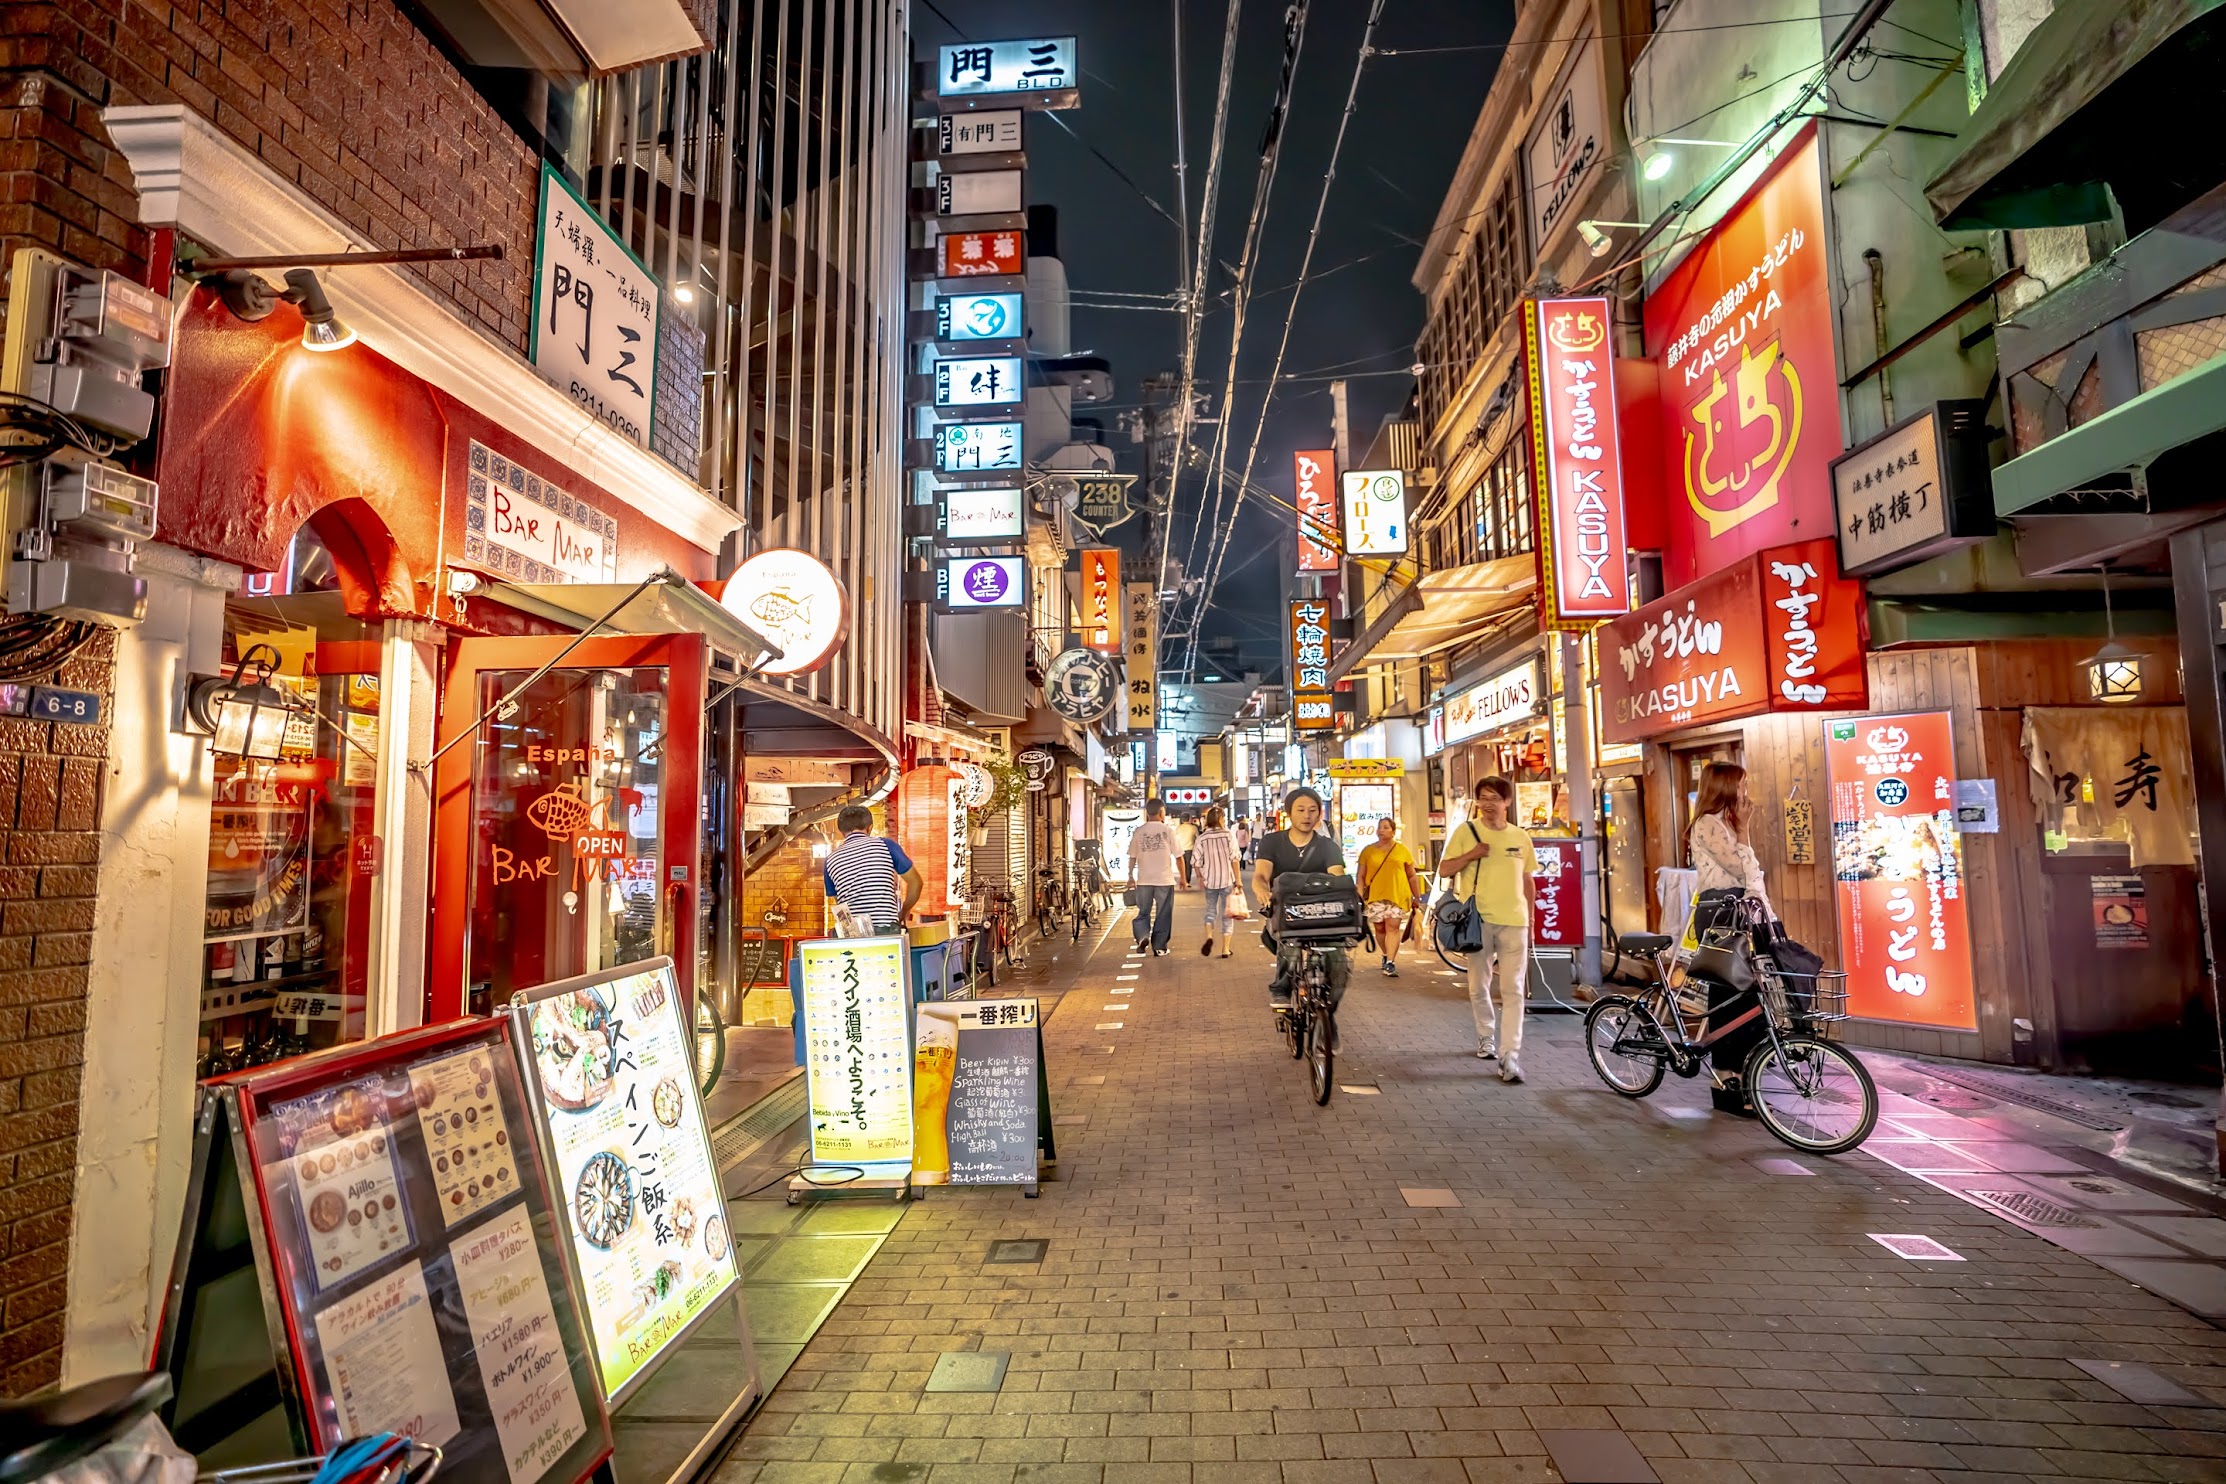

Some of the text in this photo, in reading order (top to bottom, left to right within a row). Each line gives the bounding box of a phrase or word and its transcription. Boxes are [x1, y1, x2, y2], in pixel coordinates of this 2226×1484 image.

[949, 43, 1065, 83] 門三
[1018, 77, 1067, 90] BLD.
[942, 120, 951, 150] 3F
[941, 180, 950, 211] 3F
[1542, 135, 1595, 233] FELLOWS
[1666, 226, 1805, 370] 藤井寺の元祖かすうどん
[550, 261, 645, 399] 門三
[938, 303, 949, 336] 3F
[1683, 288, 1782, 388] KASUYA
[939, 371, 950, 400] 2F
[936, 432, 945, 466] 2F
[956, 445, 1018, 469] 門三
[1852, 448, 1921, 494] 法善寺表参道
[1082, 482, 1122, 505] 238
[936, 502, 947, 531] 1F
[1082, 503, 1119, 518] COUNTER
[1848, 481, 1933, 543] 中筋横丁
[1571, 469, 1613, 600] KASUYA
[936, 568, 949, 600] BF
[972, 565, 998, 589] 煙
[1295, 603, 1328, 688] 七輪焼肉
[1618, 599, 1723, 683] かすうどん
[1770, 560, 1828, 705] かすうどん
[48, 697, 86, 716] 6-8
[1478, 678, 1530, 721] FELLOWS
[1630, 666, 1742, 720] KASUYA
[527, 744, 616, 766] España
[1856, 752, 1923, 765] KASUYA
[2114, 742, 2162, 812] 寿
[577, 836, 623, 854] OPEN
[1788, 824, 1812, 864] 営業中
[207, 859, 303, 927] FOR GOOD TIMES
[960, 1004, 1036, 1026] 一番搾り
[843, 958, 868, 1132] スペイン酒場へようこそ。
[960, 1057, 985, 1070] Beer
[954, 1075, 1026, 1089] Sparkling Wine
[954, 1097, 977, 1108] Glass
[979, 1097, 988, 1107] of
[953, 1117, 988, 1132] Whisky
[1003, 1118, 1027, 1130] Soda
[347, 1179, 376, 1200] Ajillo
[685, 1275, 719, 1308] 06-6211-1131
